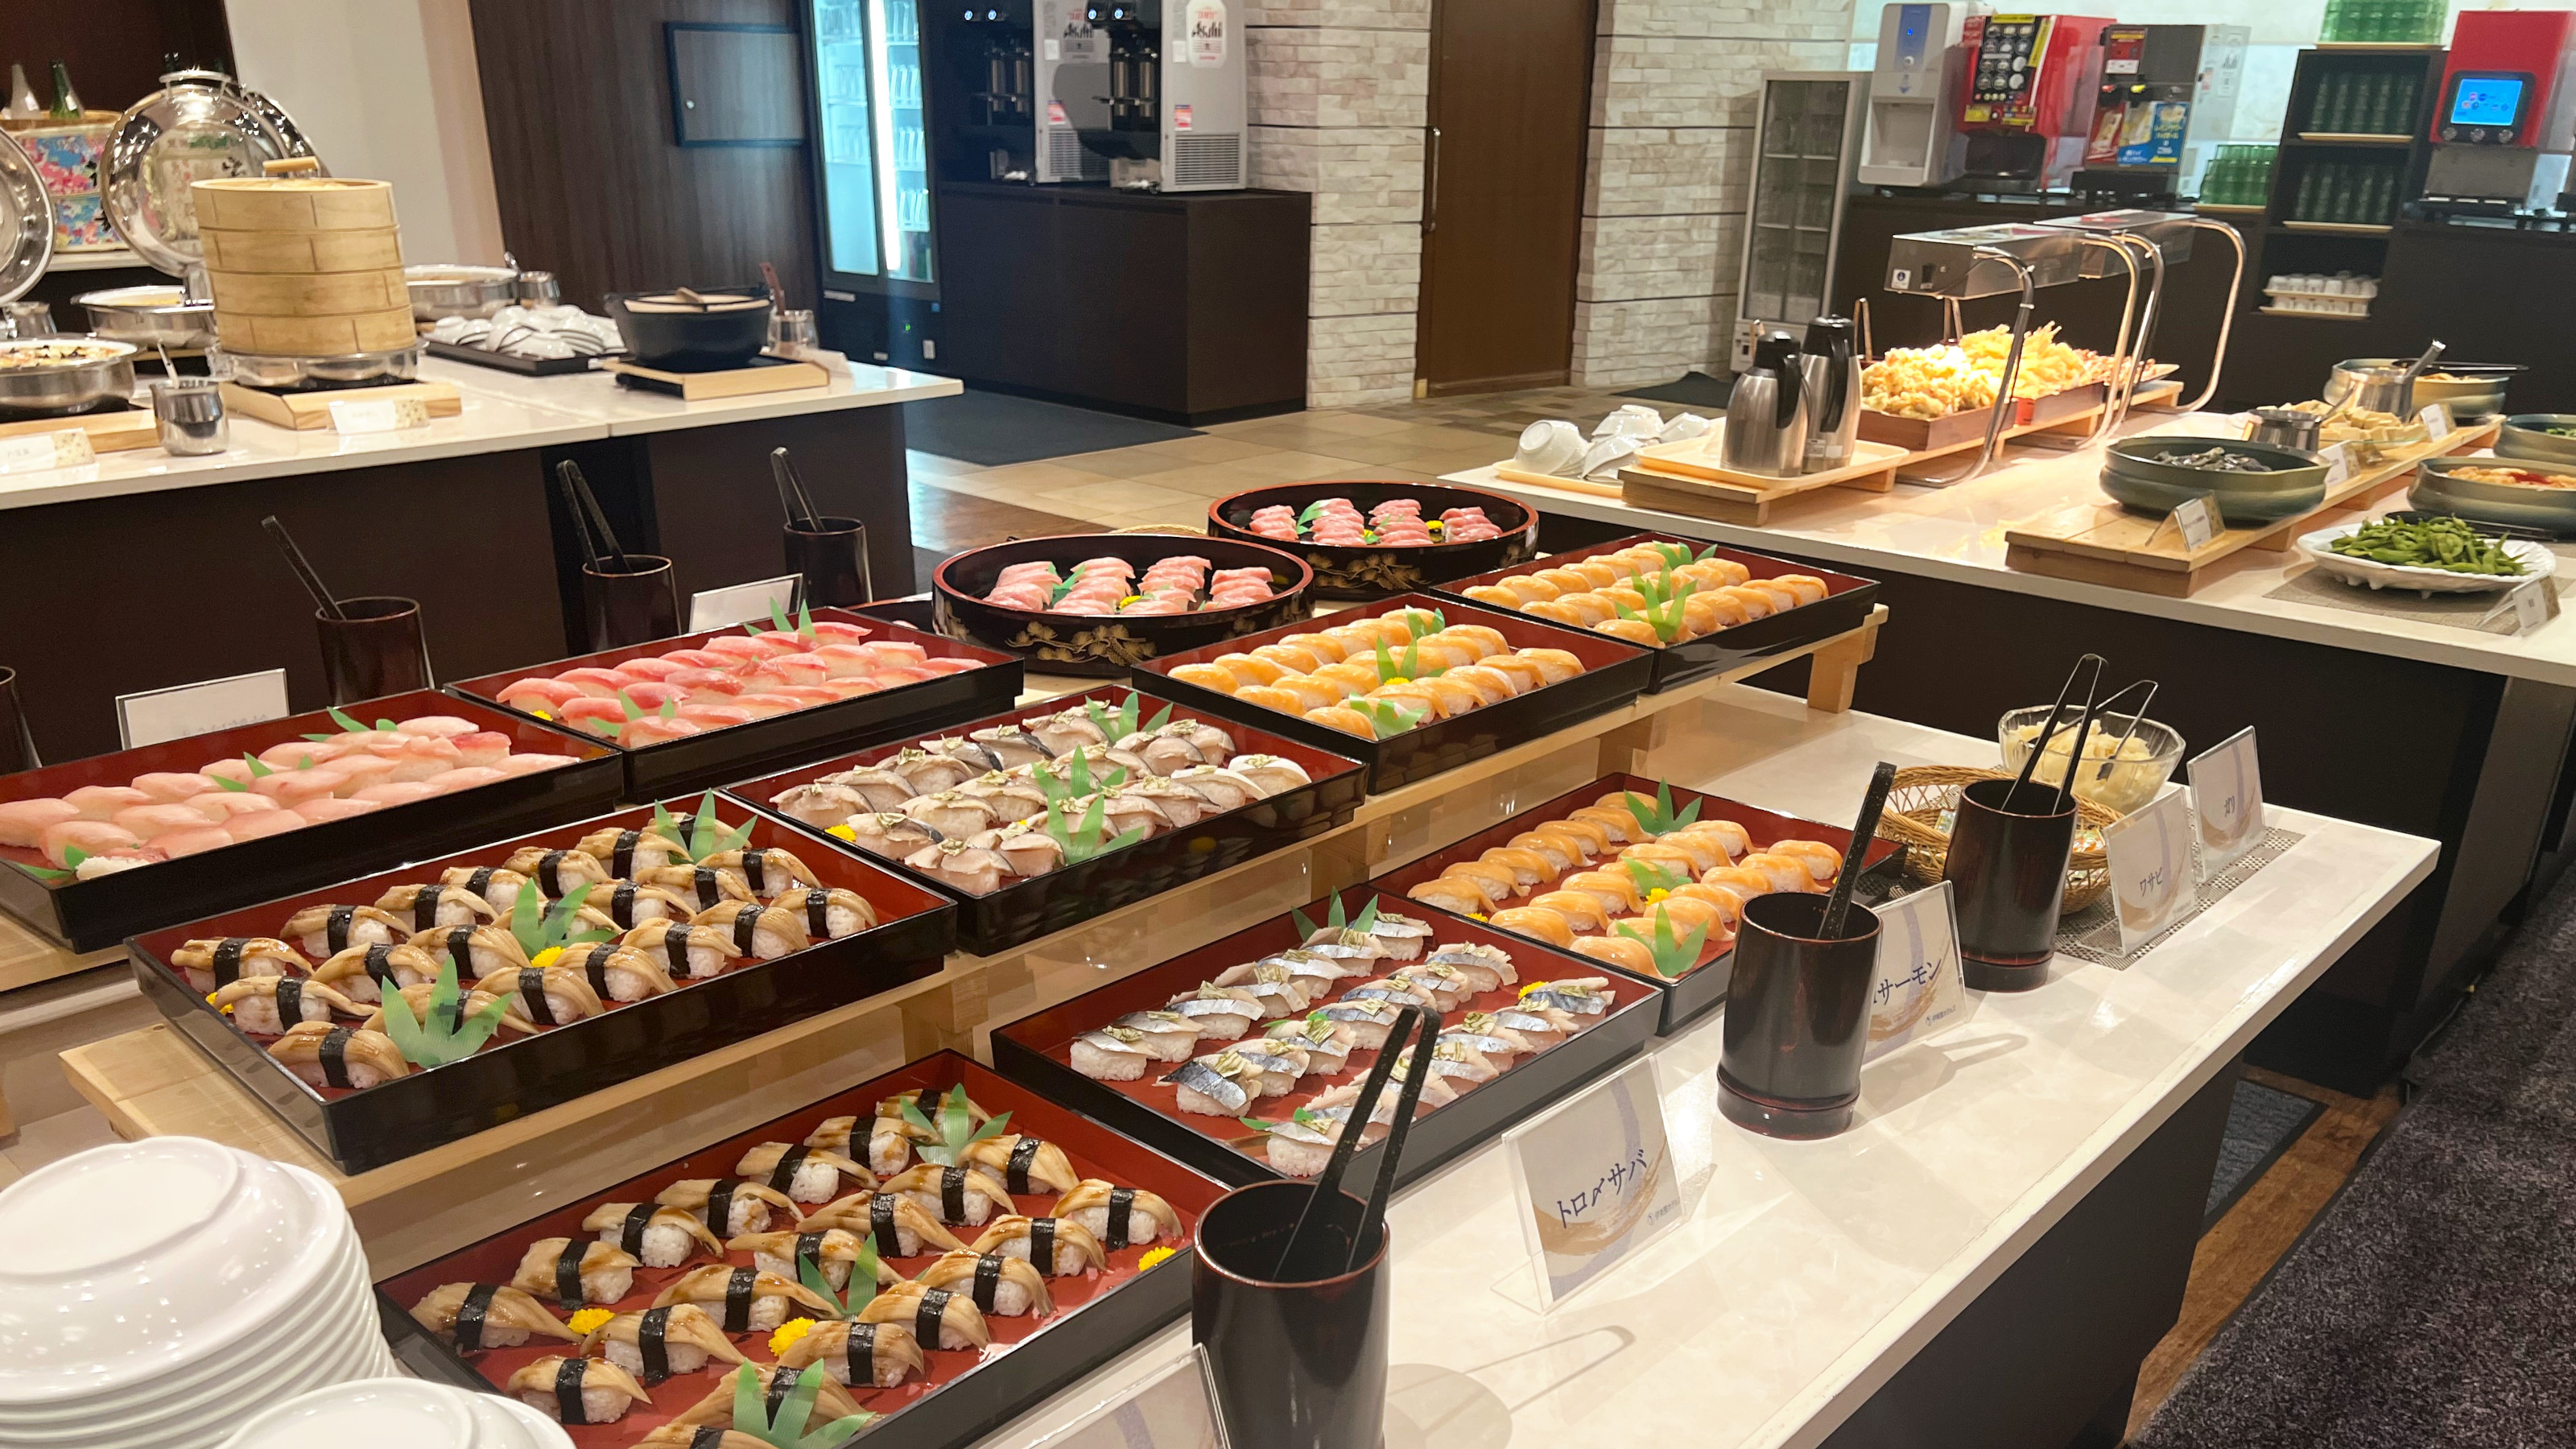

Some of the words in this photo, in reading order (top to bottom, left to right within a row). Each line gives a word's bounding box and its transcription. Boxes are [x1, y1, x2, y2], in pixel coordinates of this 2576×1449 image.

[2140, 866, 2163, 897] ワサビ
[1873, 959, 1942, 1005] サーモン
